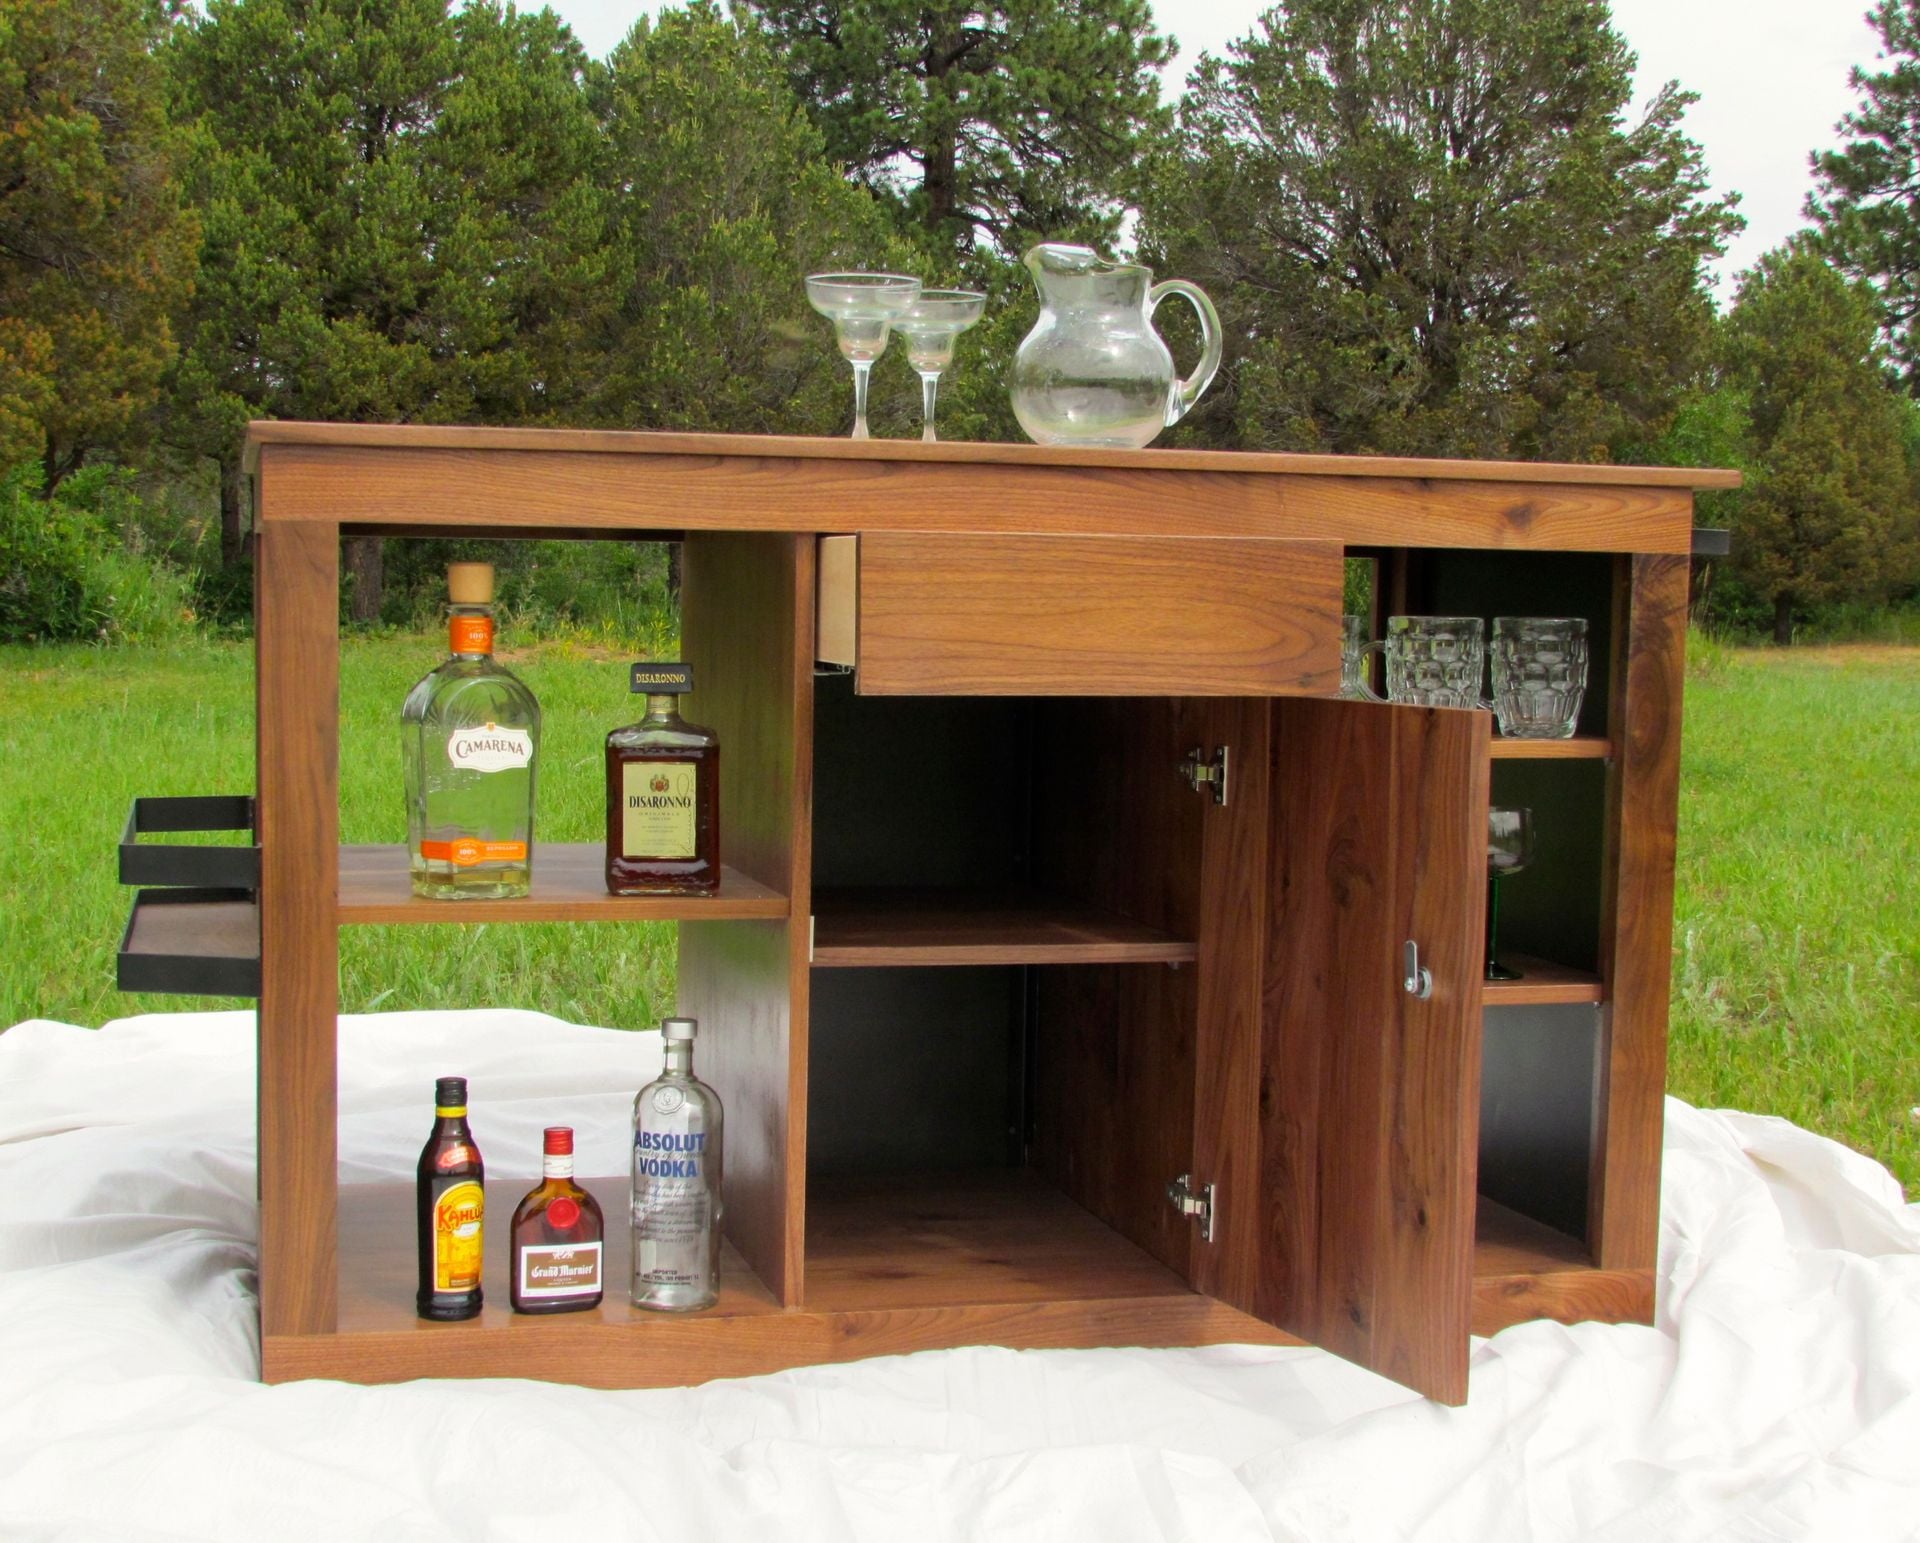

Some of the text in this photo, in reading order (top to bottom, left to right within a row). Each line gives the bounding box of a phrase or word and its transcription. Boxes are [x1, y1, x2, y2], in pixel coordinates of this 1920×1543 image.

[635, 673, 686, 684] DISARONNO
[456, 739, 524, 759] CAMARENA
[629, 795, 691, 809] DISARONNO
[634, 1130, 705, 1152] ABSOLUT
[640, 1157, 697, 1178] VODKA
[531, 1264, 594, 1279] Grand Marnier
